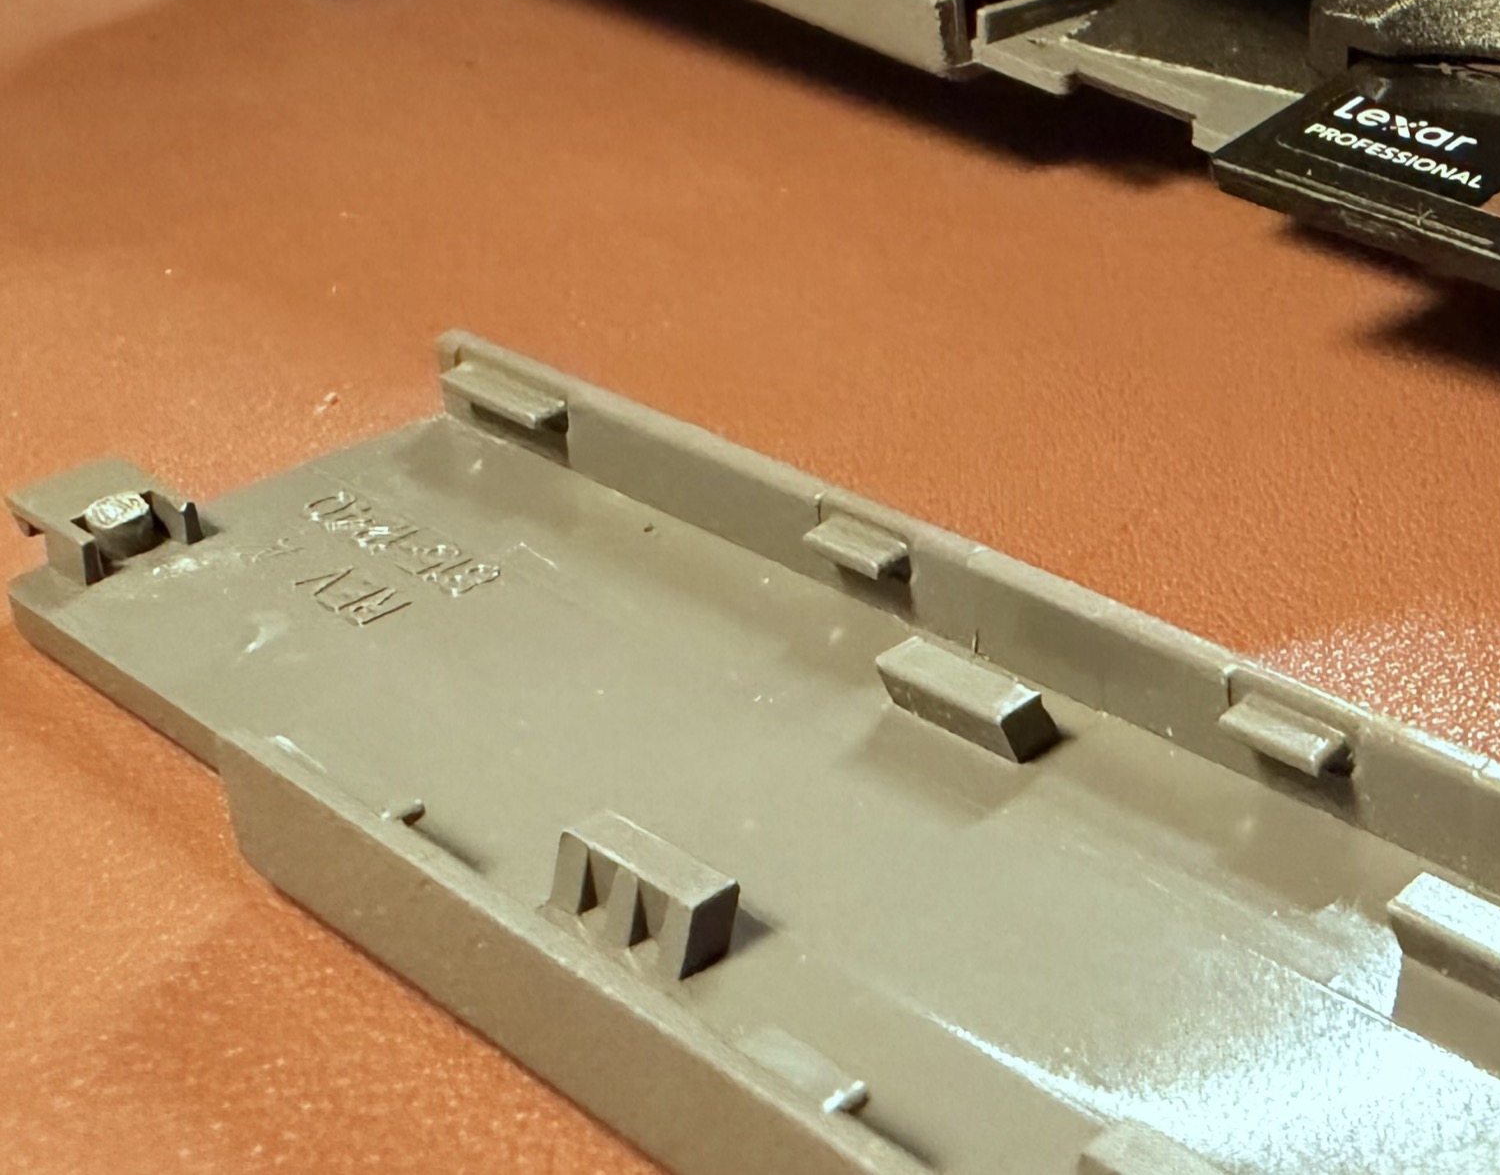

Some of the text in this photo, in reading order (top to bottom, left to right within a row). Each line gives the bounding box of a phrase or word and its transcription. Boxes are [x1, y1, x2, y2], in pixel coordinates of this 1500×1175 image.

[1332, 95, 1479, 153] Lexar
[1304, 122, 1482, 190] PROFESSIONAL
[293, 566, 414, 628] REV
